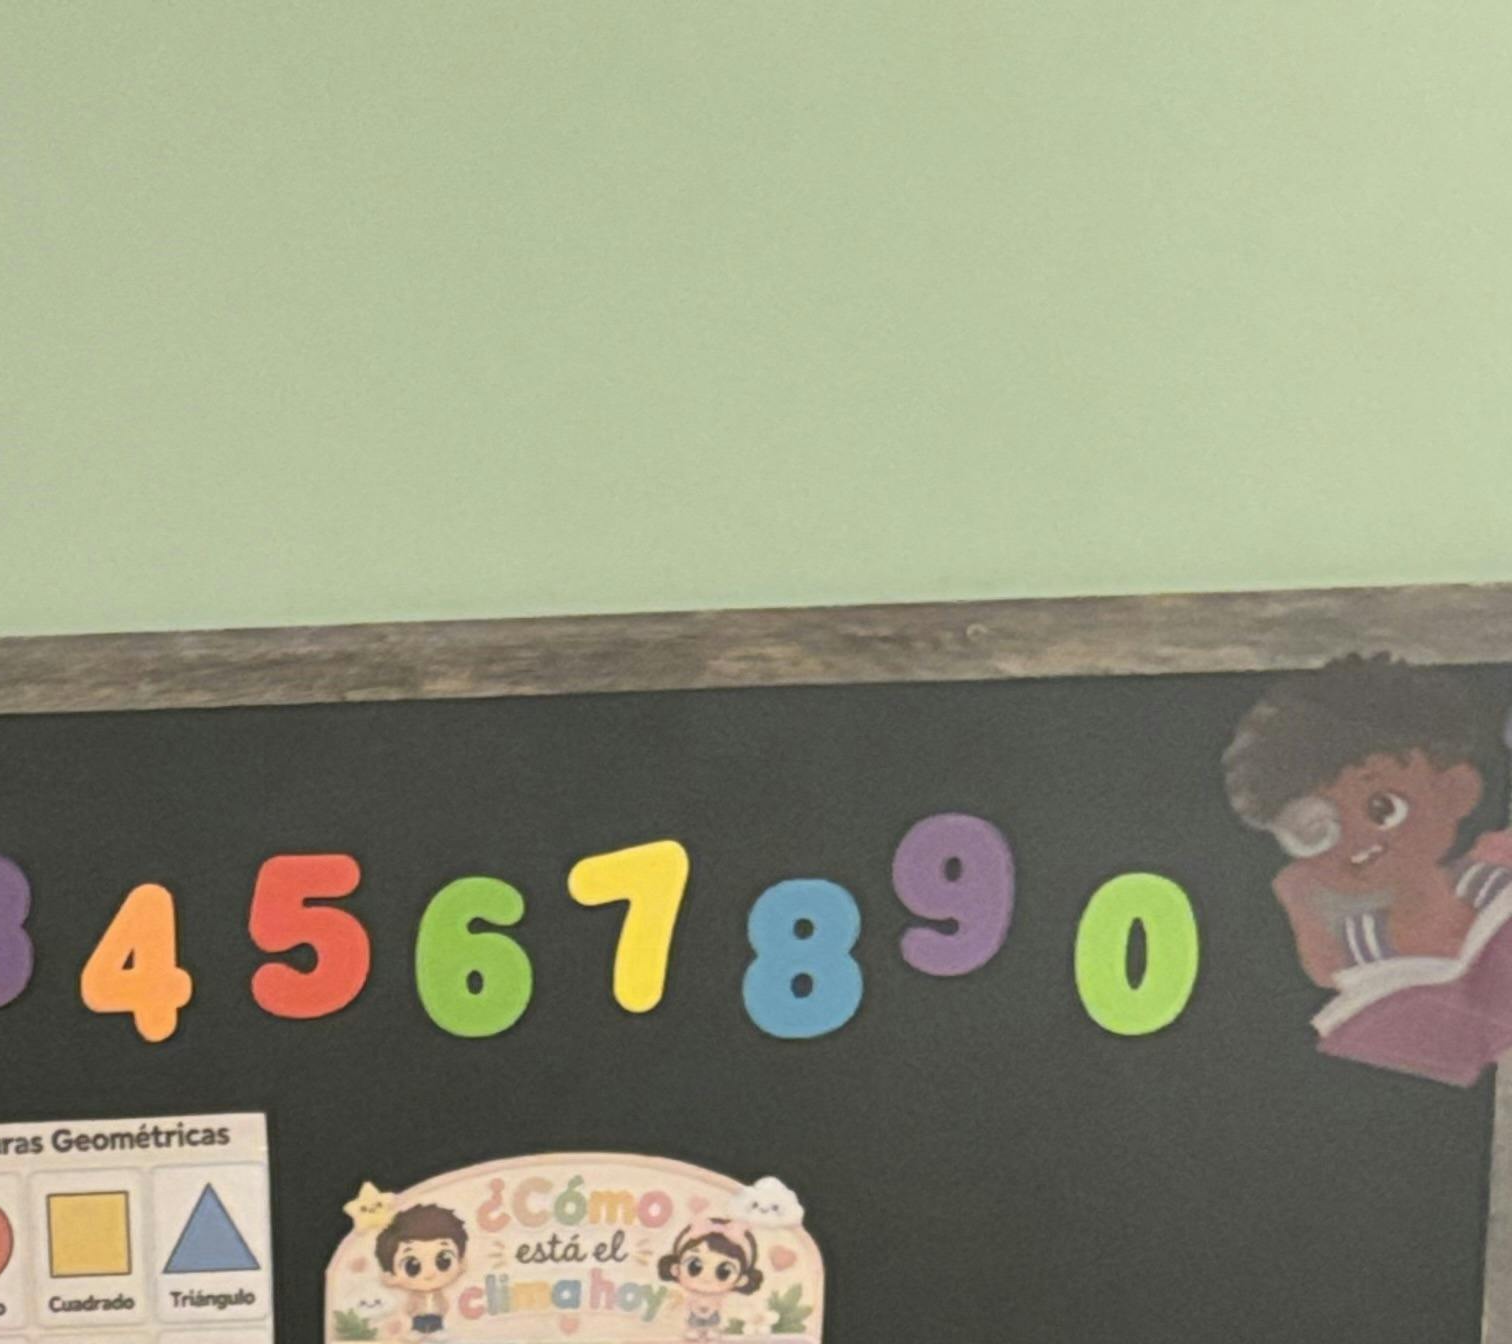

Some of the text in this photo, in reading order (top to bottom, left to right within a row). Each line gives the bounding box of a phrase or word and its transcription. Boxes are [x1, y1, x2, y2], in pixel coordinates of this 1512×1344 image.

[81, 883, 193, 1043] 4
[249, 854, 371, 1019] 5
[415, 876, 533, 1038] 6
[568, 839, 690, 1014] 7
[742, 877, 864, 1040] 8
[892, 812, 1015, 977] 9
[1074, 871, 1199, 1037] 0
[50, 1121, 231, 1154] Geométricas
[476, 1174, 674, 1231] ¿Cómo
[515, 1229, 629, 1265] está el
[48, 1294, 135, 1313] Cuadrado
[170, 1288, 256, 1310] Triángulo
[458, 1267, 670, 1323] clima hoy
